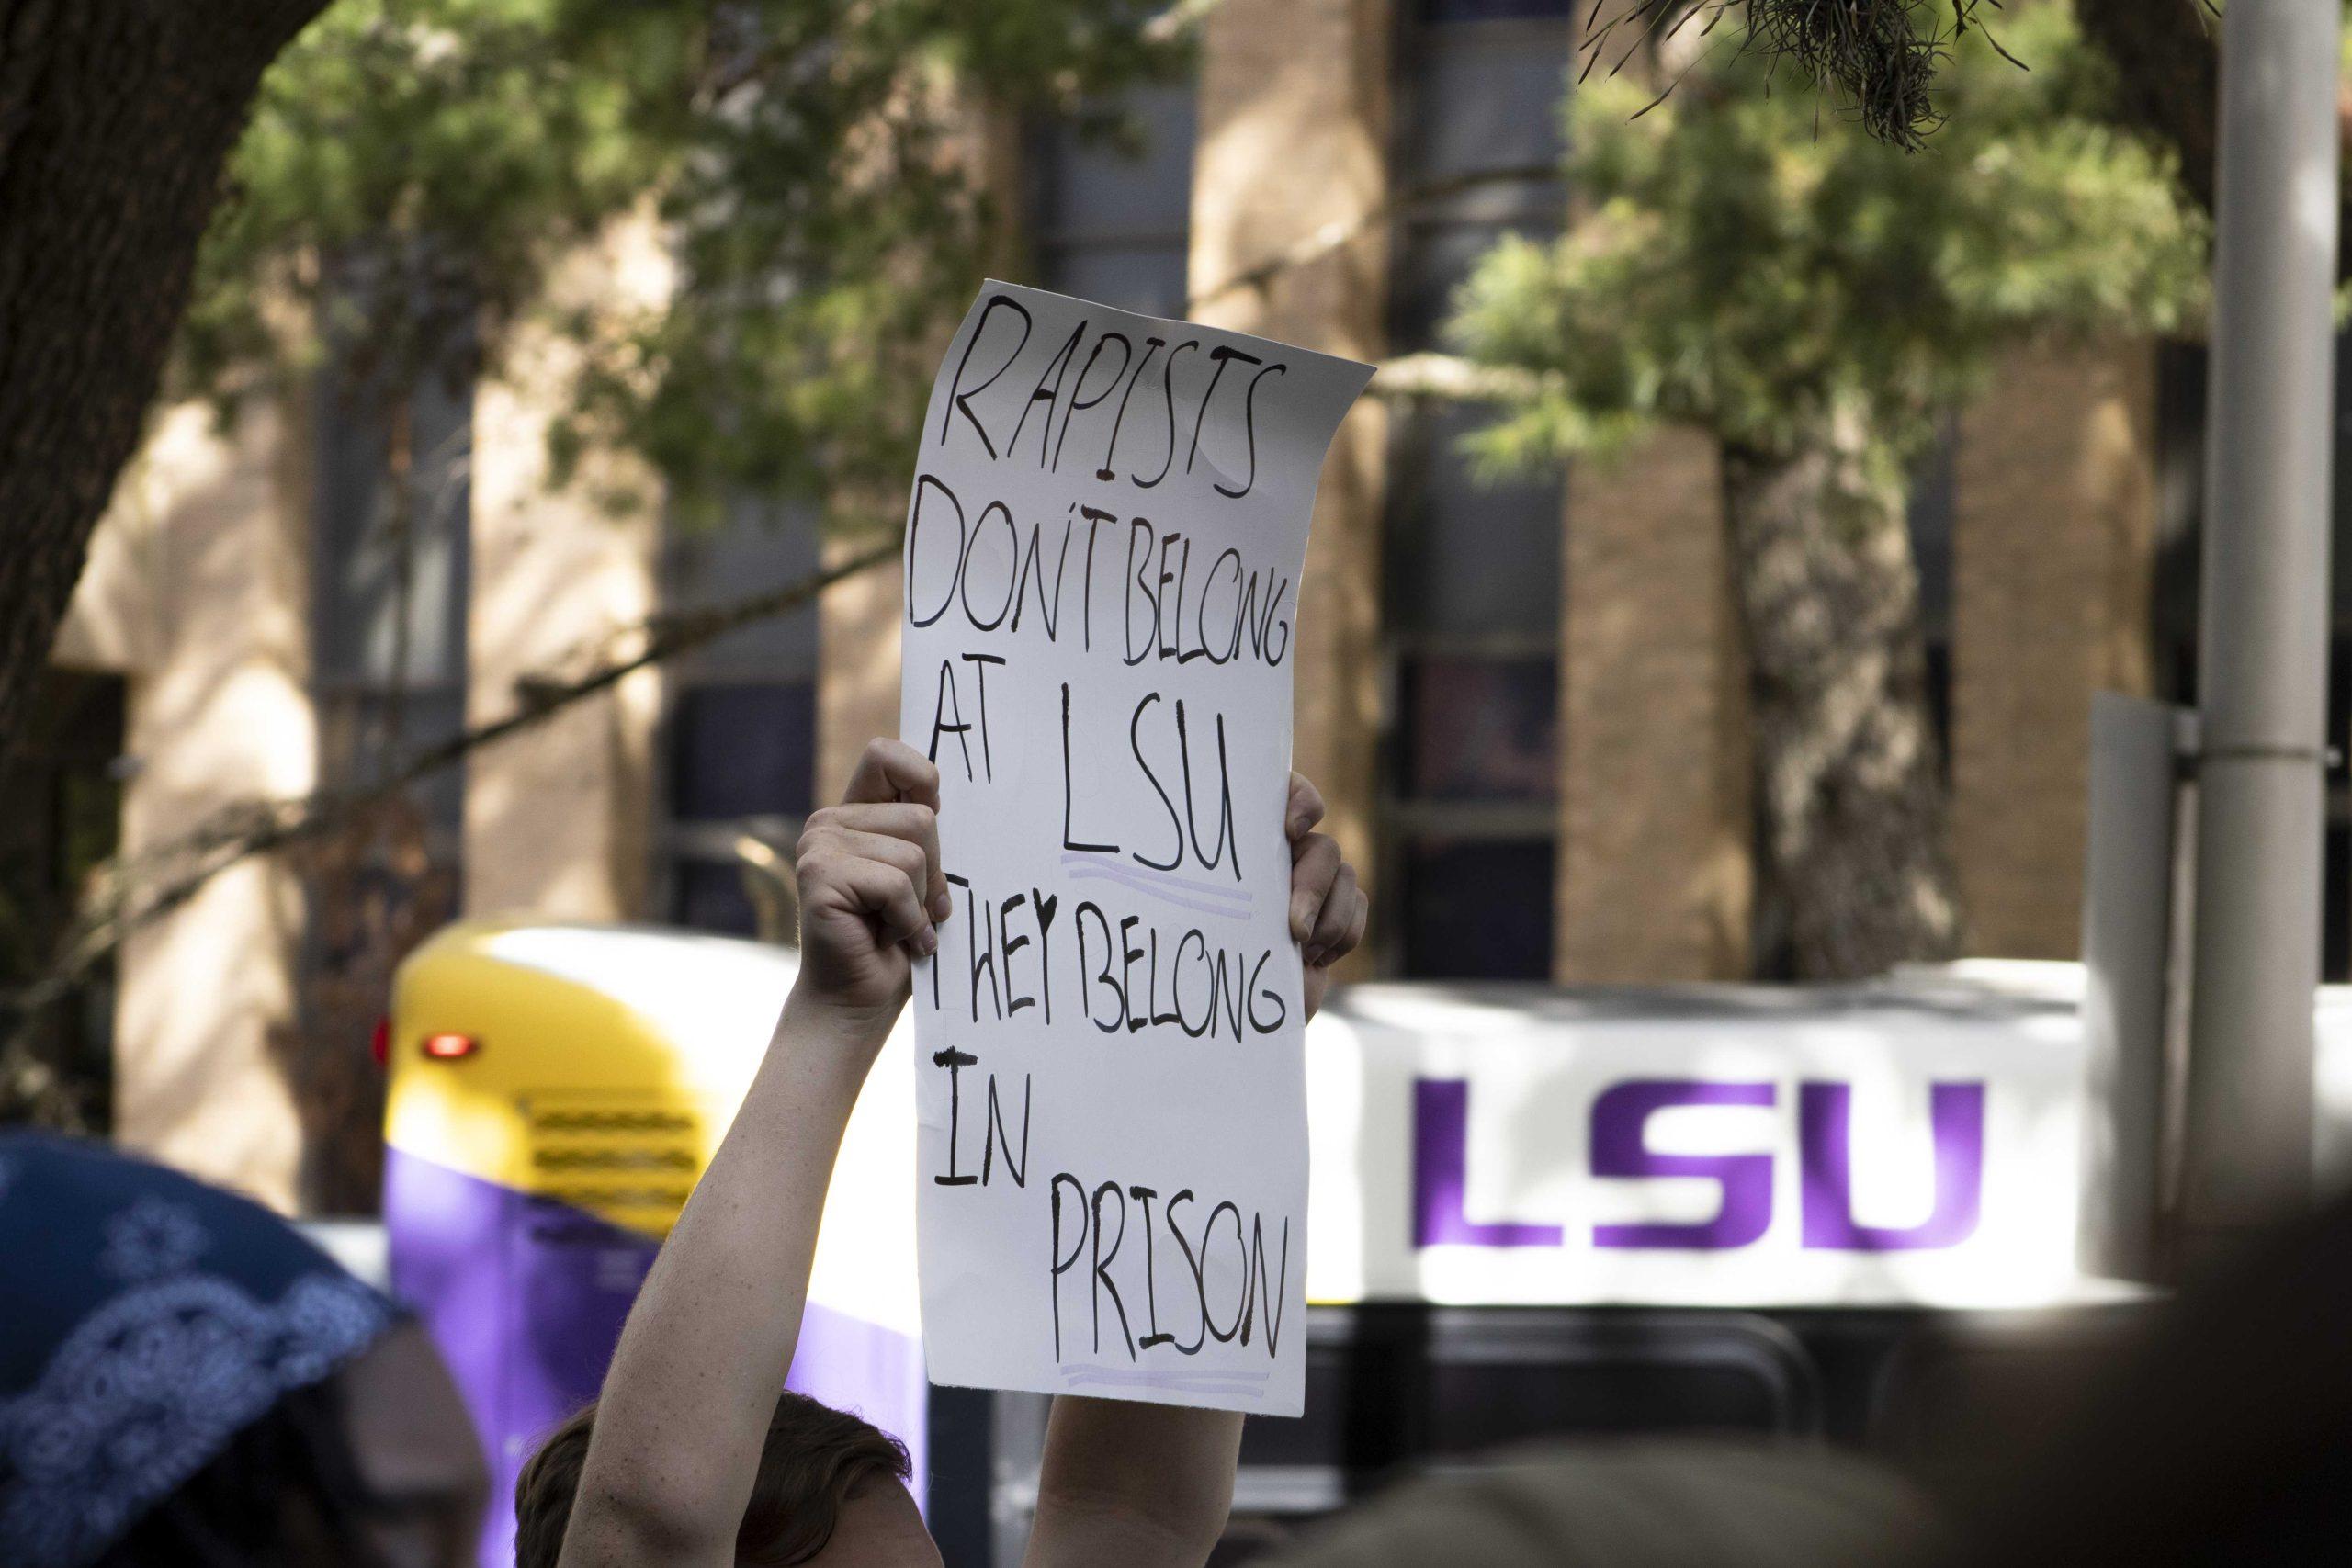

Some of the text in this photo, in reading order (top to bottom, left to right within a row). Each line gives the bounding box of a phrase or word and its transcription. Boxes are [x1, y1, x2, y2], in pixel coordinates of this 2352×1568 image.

[941, 295, 1286, 498] RAPISTS
[910, 474, 1287, 666] DON'T BELONG
[928, 653, 1241, 881] AT LSU
[1075, 901, 1285, 1043] BELONG
[933, 1045, 1031, 1188] IN
[1412, 1079, 1985, 1250] LSU
[1050, 1172, 1288, 1363] PRISON
